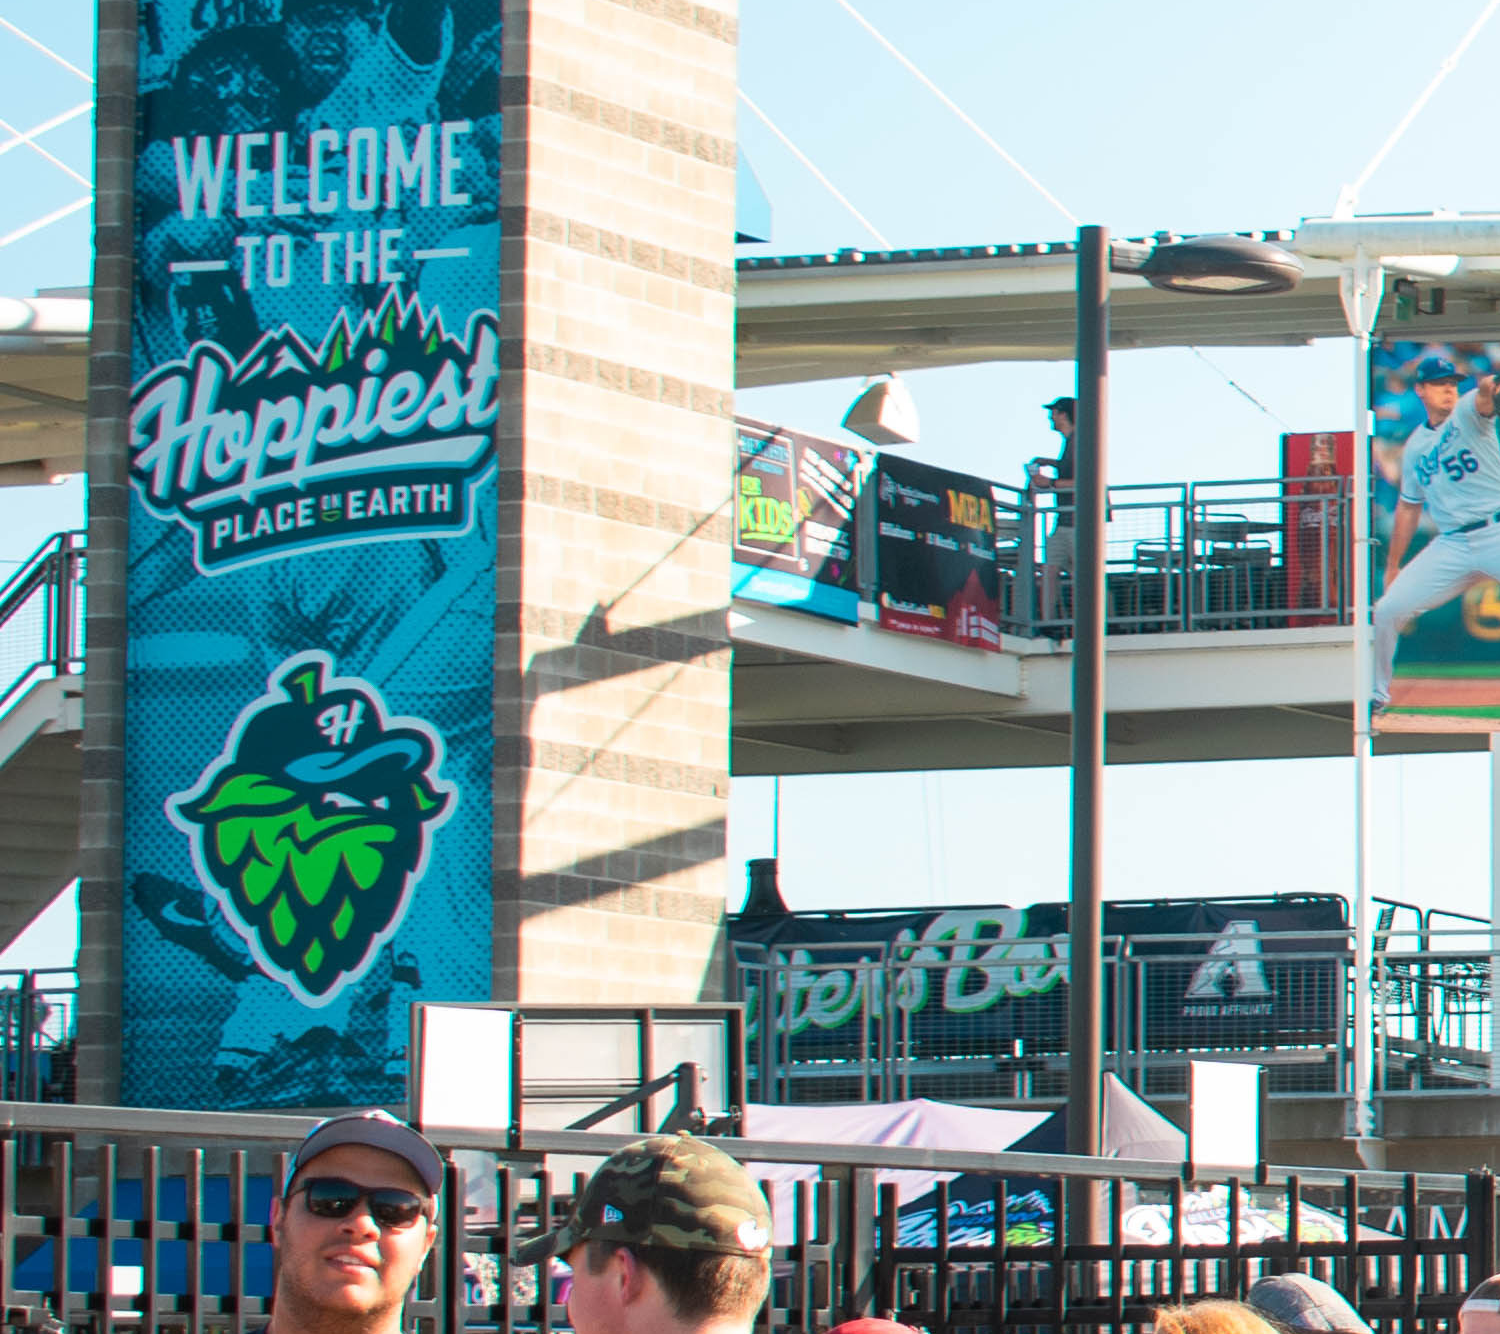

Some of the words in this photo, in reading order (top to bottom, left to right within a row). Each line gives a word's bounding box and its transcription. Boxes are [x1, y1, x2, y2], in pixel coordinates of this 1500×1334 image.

[172, 120, 475, 220] WELCOME
[236, 234, 294, 291] TO
[314, 228, 408, 285] THE
[129, 320, 500, 507] Hoppiest
[1440, 448, 1479, 483] 56
[211, 497, 316, 549] PLACE
[322, 494, 342, 510] ON
[348, 483, 453, 519] EARTH
[739, 495, 796, 537] KIDS
[947, 486, 994, 534] MBA
[315, 699, 366, 746] H
[1220, 1003, 1273, 1016] AFFILIATE
